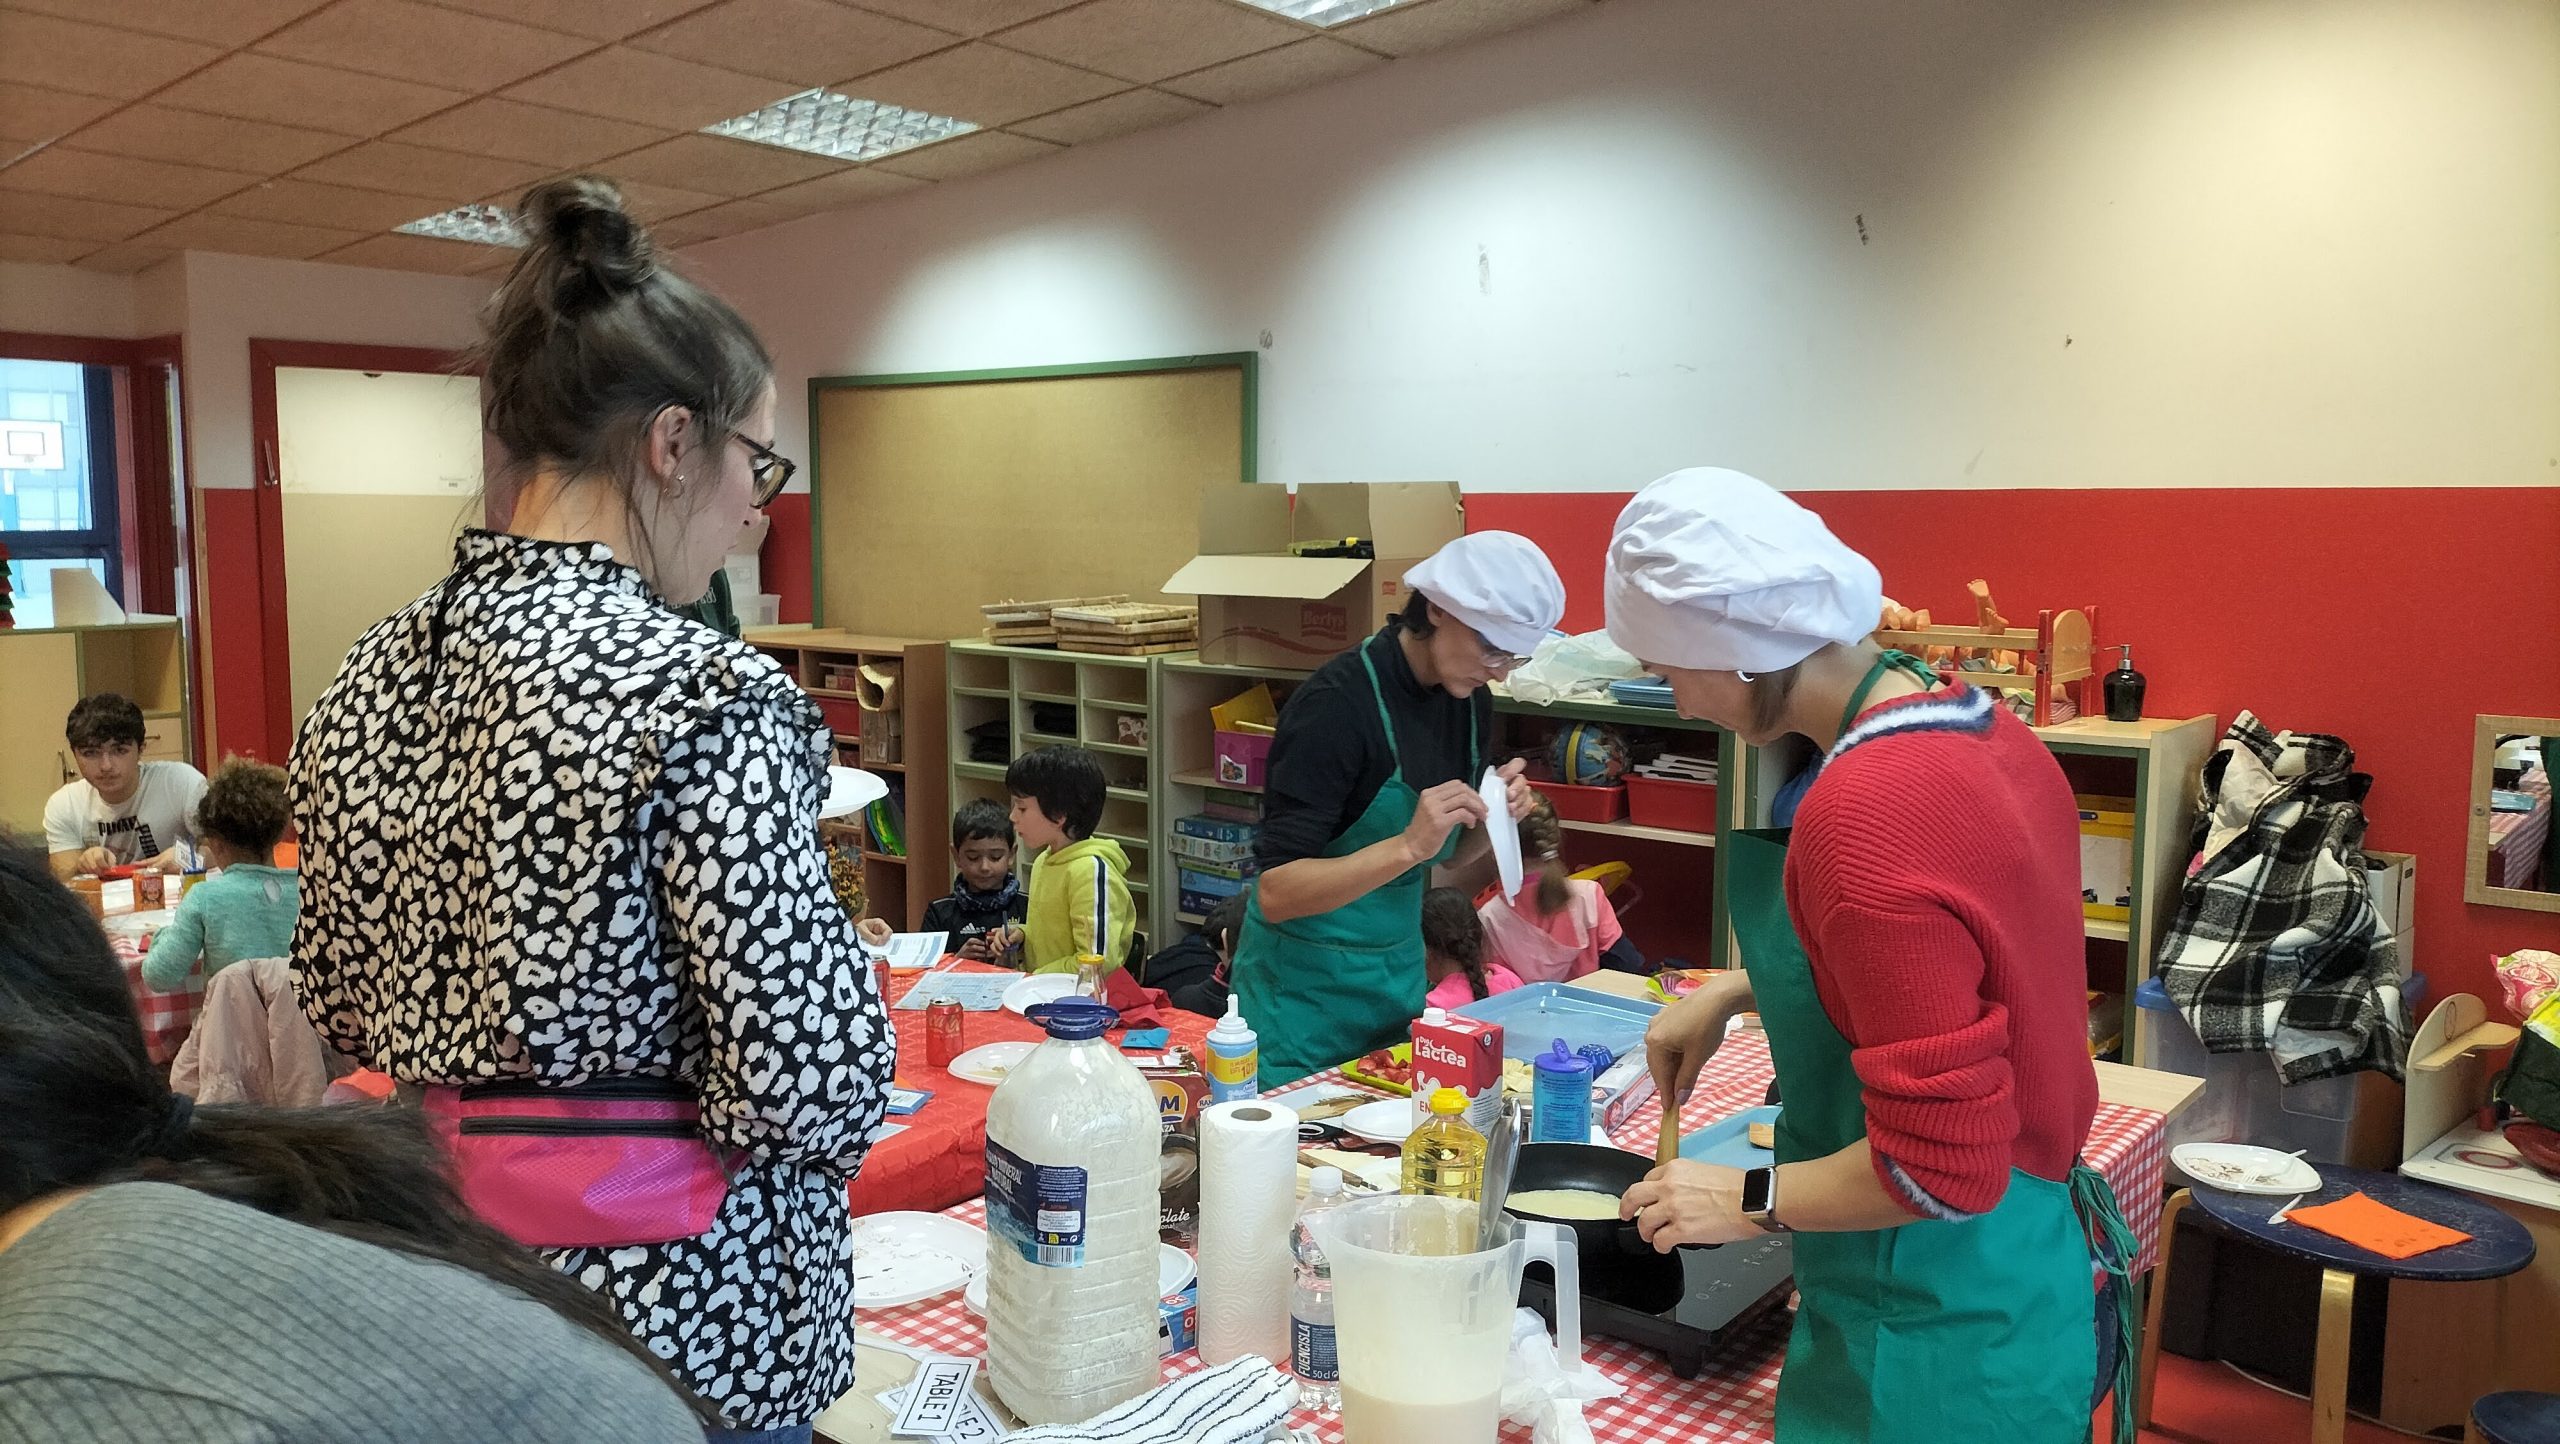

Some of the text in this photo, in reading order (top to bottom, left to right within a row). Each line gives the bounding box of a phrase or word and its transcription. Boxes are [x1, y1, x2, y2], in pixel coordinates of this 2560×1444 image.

[1298, 1324, 1310, 1377] FUENCISLA
[1312, 1370, 1322, 1378] 50
[917, 1372, 960, 1421] TABLE 1
[960, 1427, 985, 1440] 2
